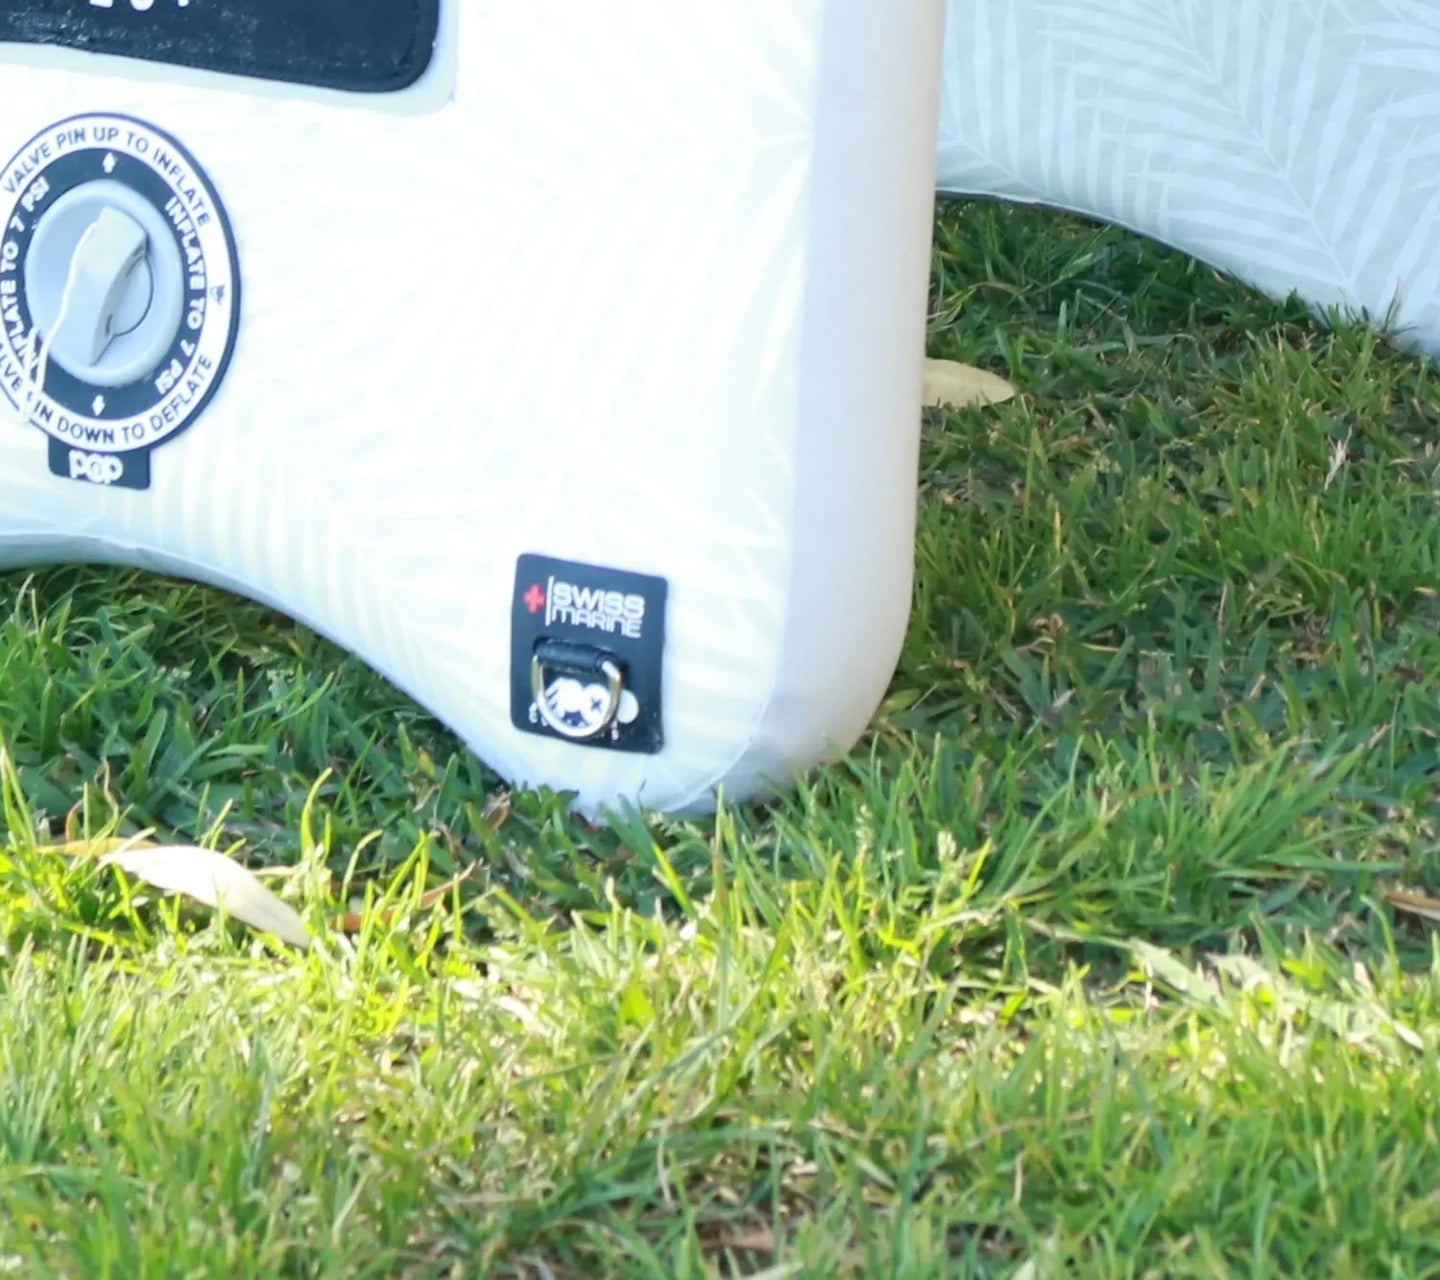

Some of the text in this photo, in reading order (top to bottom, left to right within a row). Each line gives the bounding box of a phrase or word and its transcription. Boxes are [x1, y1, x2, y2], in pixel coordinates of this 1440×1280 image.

[0, 241, 20, 272] TO
[10, 214, 25, 233] 7
[21, 175, 50, 212] PSI
[3, 126, 211, 228] VALVE PIN UP TO INFLATE
[154, 195, 207, 395] INFLATE TO 7 PSI
[57, 417, 115, 444] DOWN
[121, 423, 145, 443] TO
[150, 354, 212, 431] DEFLATE
[552, 581, 645, 620] SWISS
